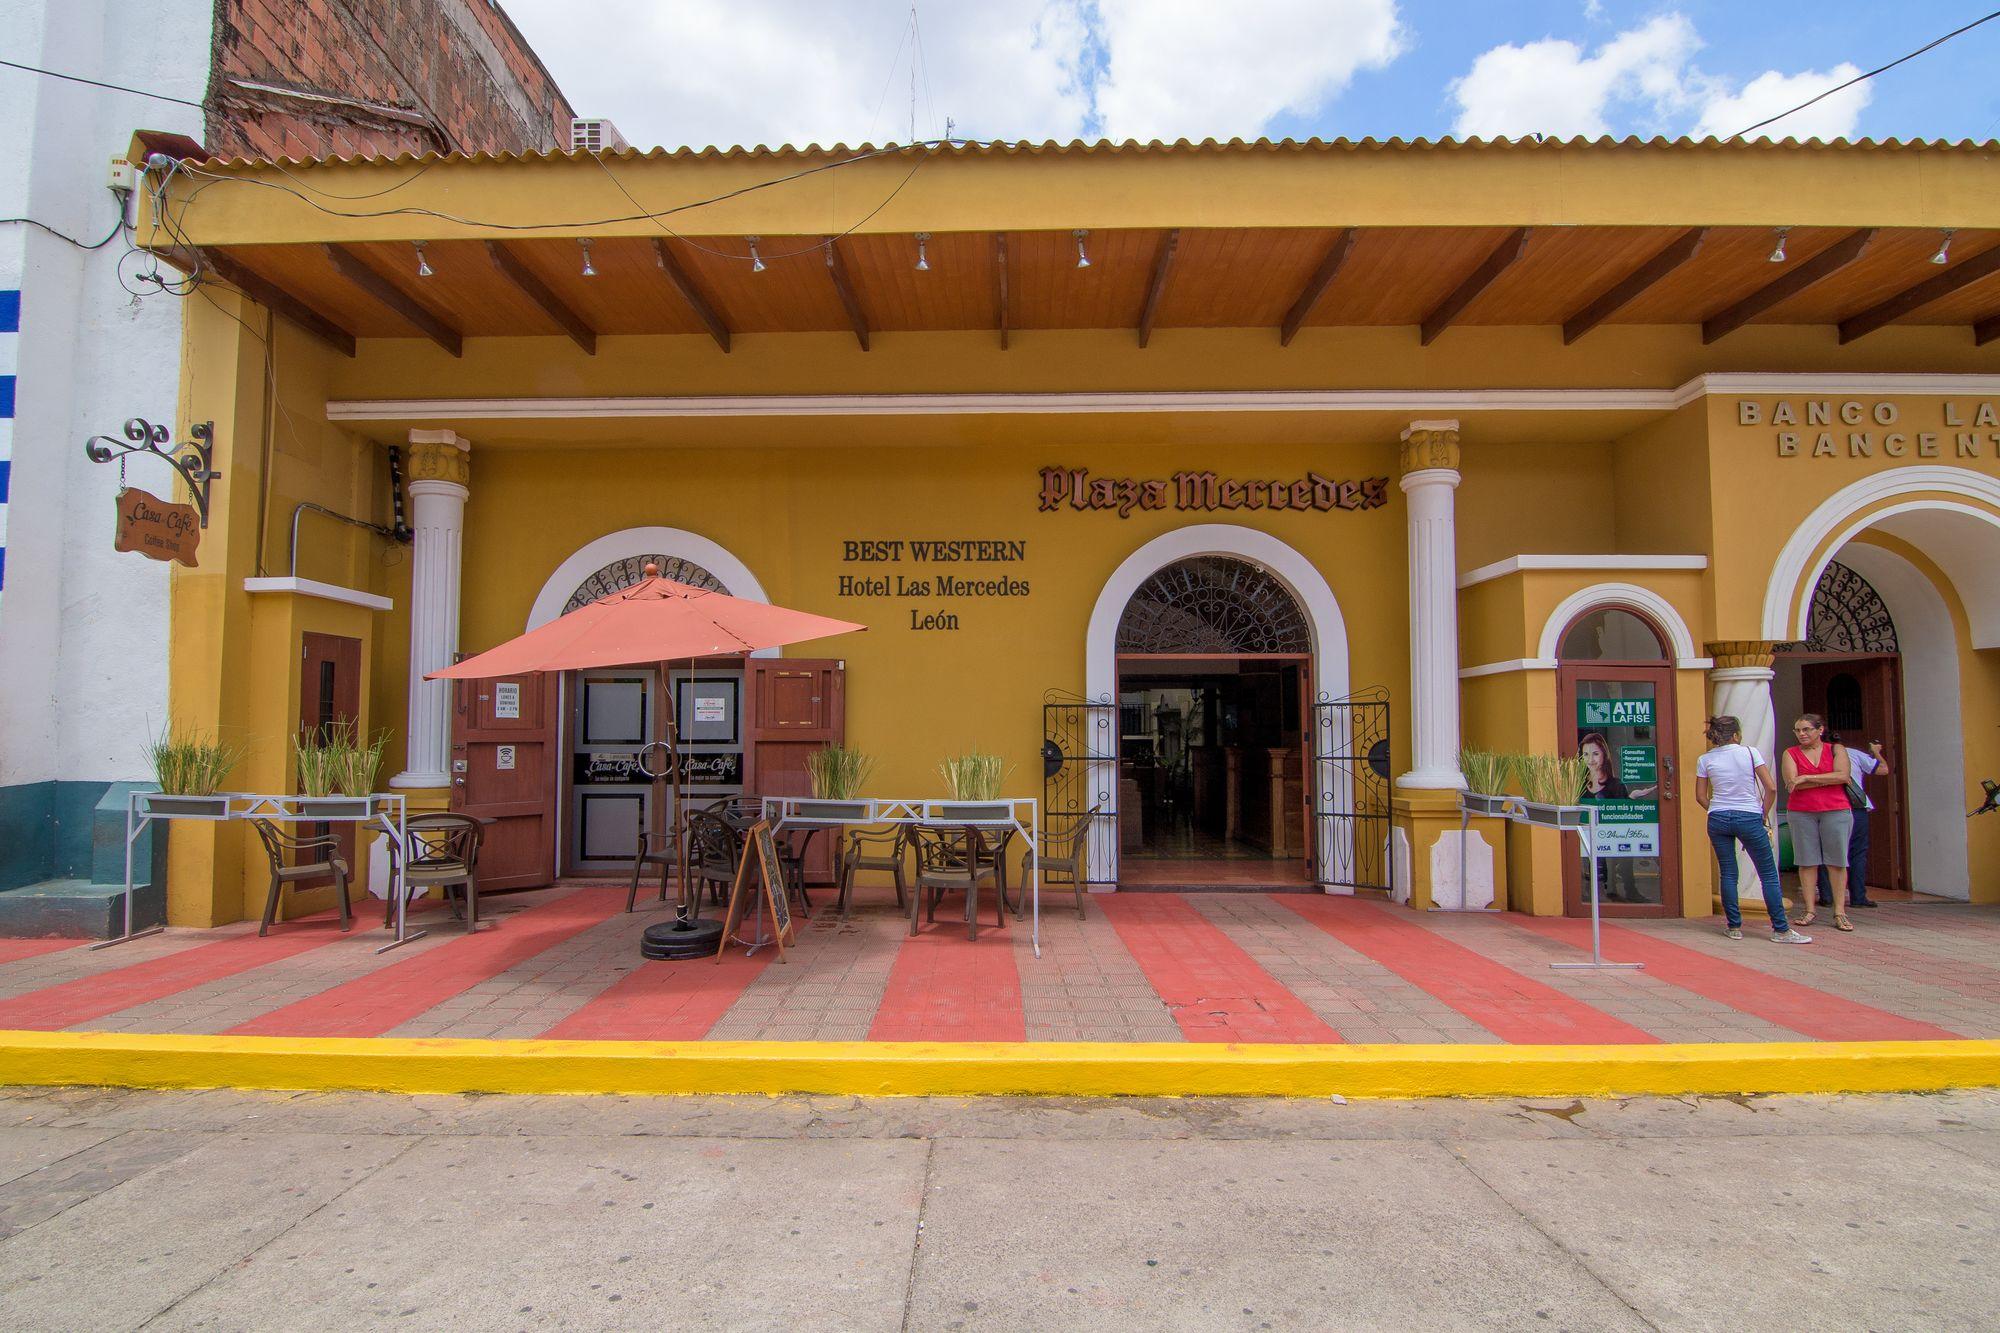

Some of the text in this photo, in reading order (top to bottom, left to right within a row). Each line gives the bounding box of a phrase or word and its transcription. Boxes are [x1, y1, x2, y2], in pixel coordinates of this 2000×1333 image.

[1738, 400, 2000, 427] BANCO LA
[1038, 465, 1390, 519] Plaza Mercedes
[133, 502, 192, 538] Casa Café
[843, 541, 1026, 562] BEST WESTERN
[838, 576, 1030, 596] Hotel Las Mercedes
[910, 609, 959, 630] León
[1613, 701, 1650, 714] ATM
[1612, 714, 1651, 723] LAFISE
[590, 760, 612, 772] Casa
[615, 759, 638, 776] Café
[685, 759, 707, 771] Casa
[711, 758, 733, 775] Café
[1634, 804, 1656, 812] mejores
